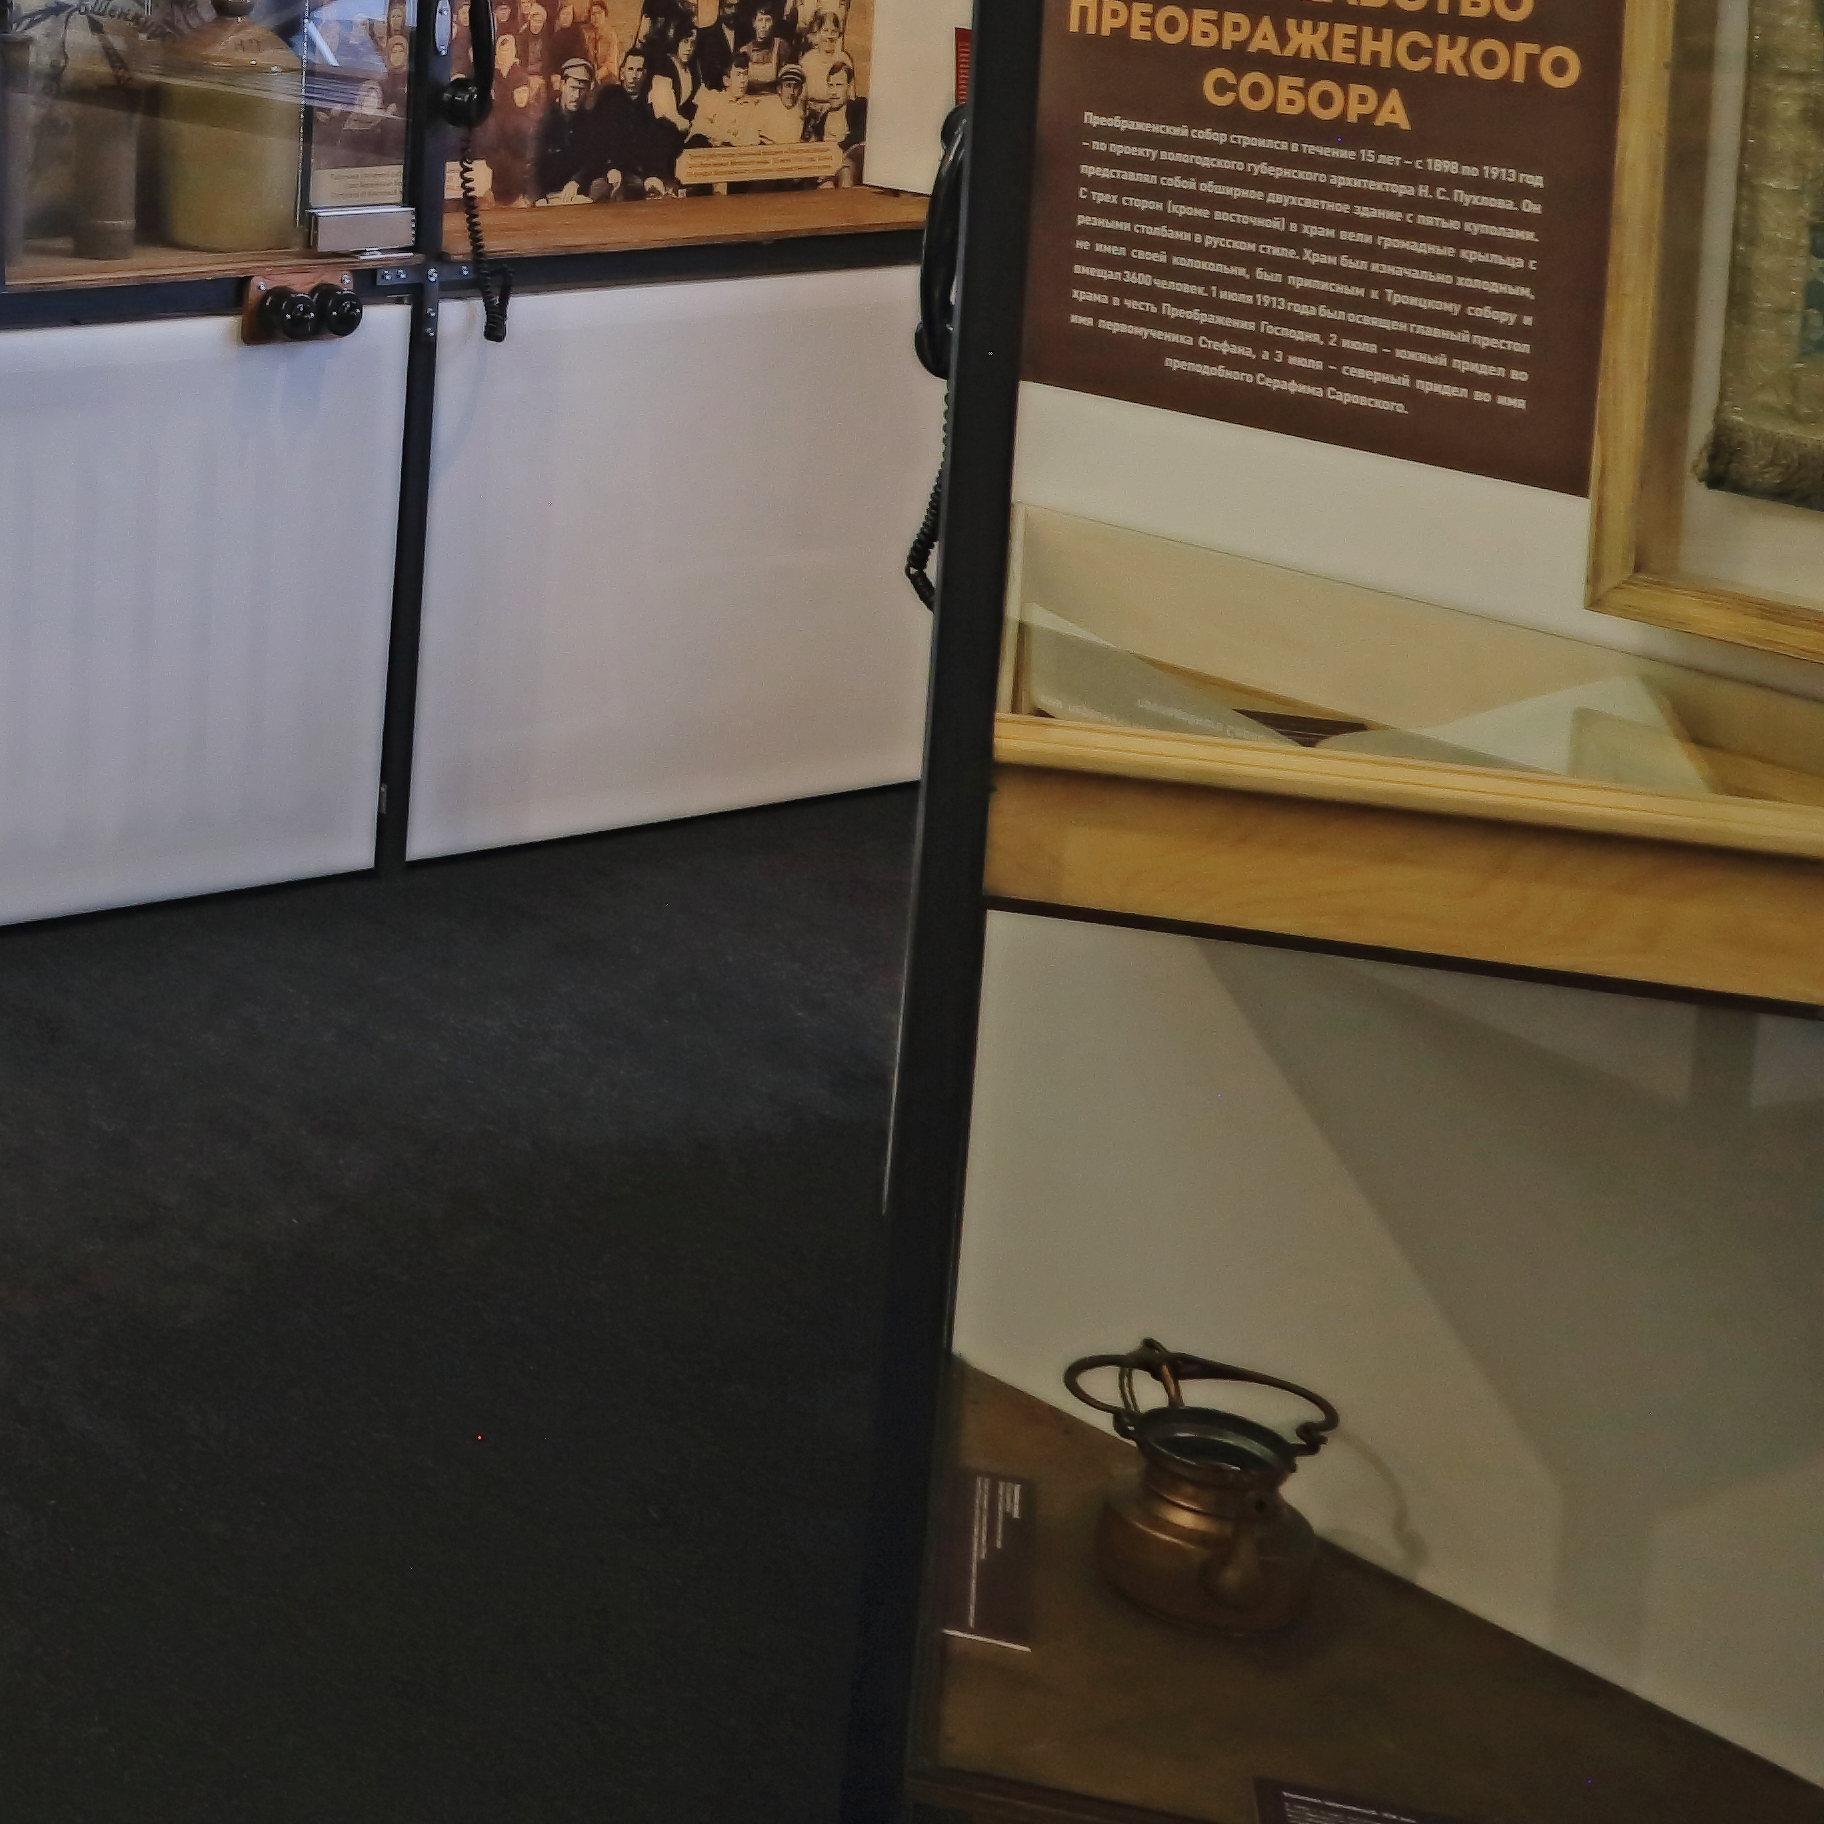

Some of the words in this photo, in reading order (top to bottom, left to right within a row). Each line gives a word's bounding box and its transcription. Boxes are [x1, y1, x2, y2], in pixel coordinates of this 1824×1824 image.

[1203, 67, 1411, 131] СОБОРА
[1084, 112, 1188, 138] Преображенский
[1191, 129, 1227, 144] собор
[1230, 133, 1288, 152] строился
[1291, 142, 1298, 152] в
[1302, 143, 1356, 160] течение
[1360, 149, 1374, 163] 15
[1378, 154, 1401, 166] лет
[1414, 160, 1423, 170] с
[1427, 158, 1458, 174] 1898
[1462, 164, 1479, 177] по
[1483, 165, 1515, 182] 1913
[1519, 173, 1544, 188] год
[1092, 140, 1106, 151] по
[1110, 143, 1158, 160] проекту
[1160, 150, 1244, 172] вологодского
[1247, 161, 1327, 183] губернского
[1330, 174, 1414, 197] архитектора
[1418, 184, 1432, 198] Н.
[1436, 186, 1450, 200] С.
[1522, 199, 1542, 214] Он
[1164, 357, 1253, 384] преподобного
[1256, 372, 1323, 398] Серафима
[1326, 387, 1408, 414] Саровского.
